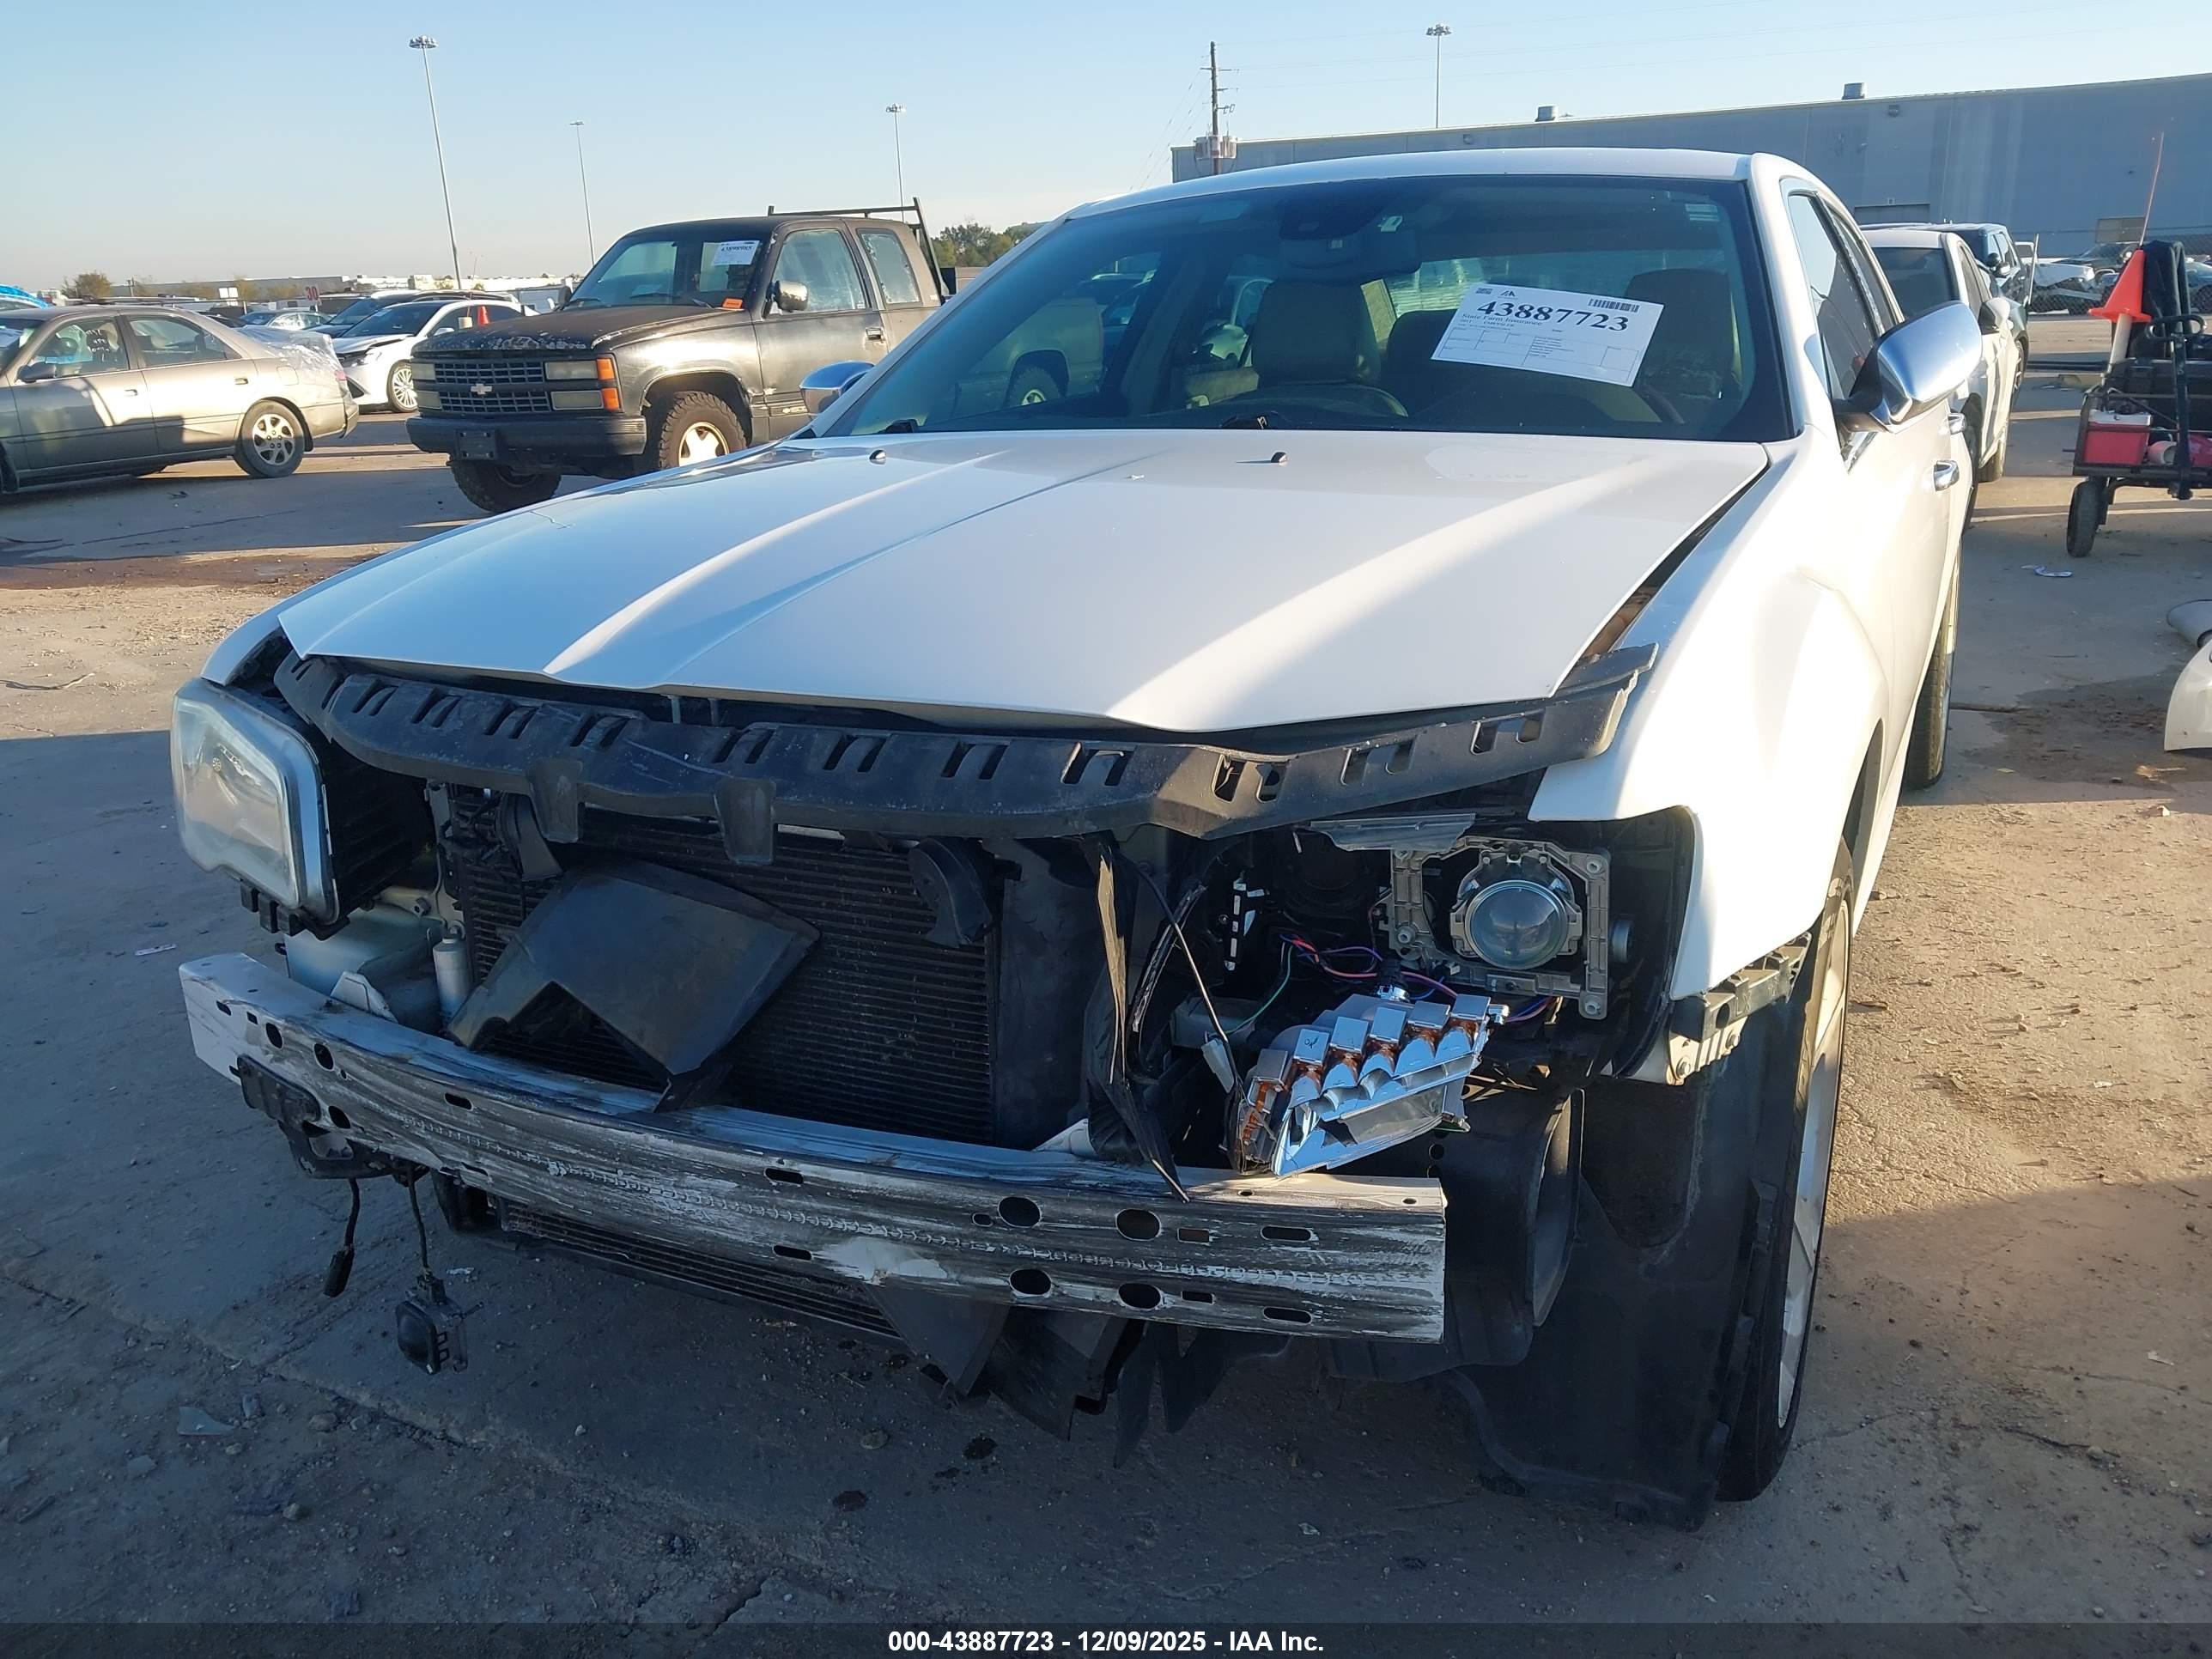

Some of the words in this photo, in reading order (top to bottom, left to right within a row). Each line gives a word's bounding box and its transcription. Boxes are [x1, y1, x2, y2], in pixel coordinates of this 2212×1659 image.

[305, 286, 319, 301] 30
[1477, 301, 1629, 331] 43887723
[1504, 317, 1542, 326] Insurance
